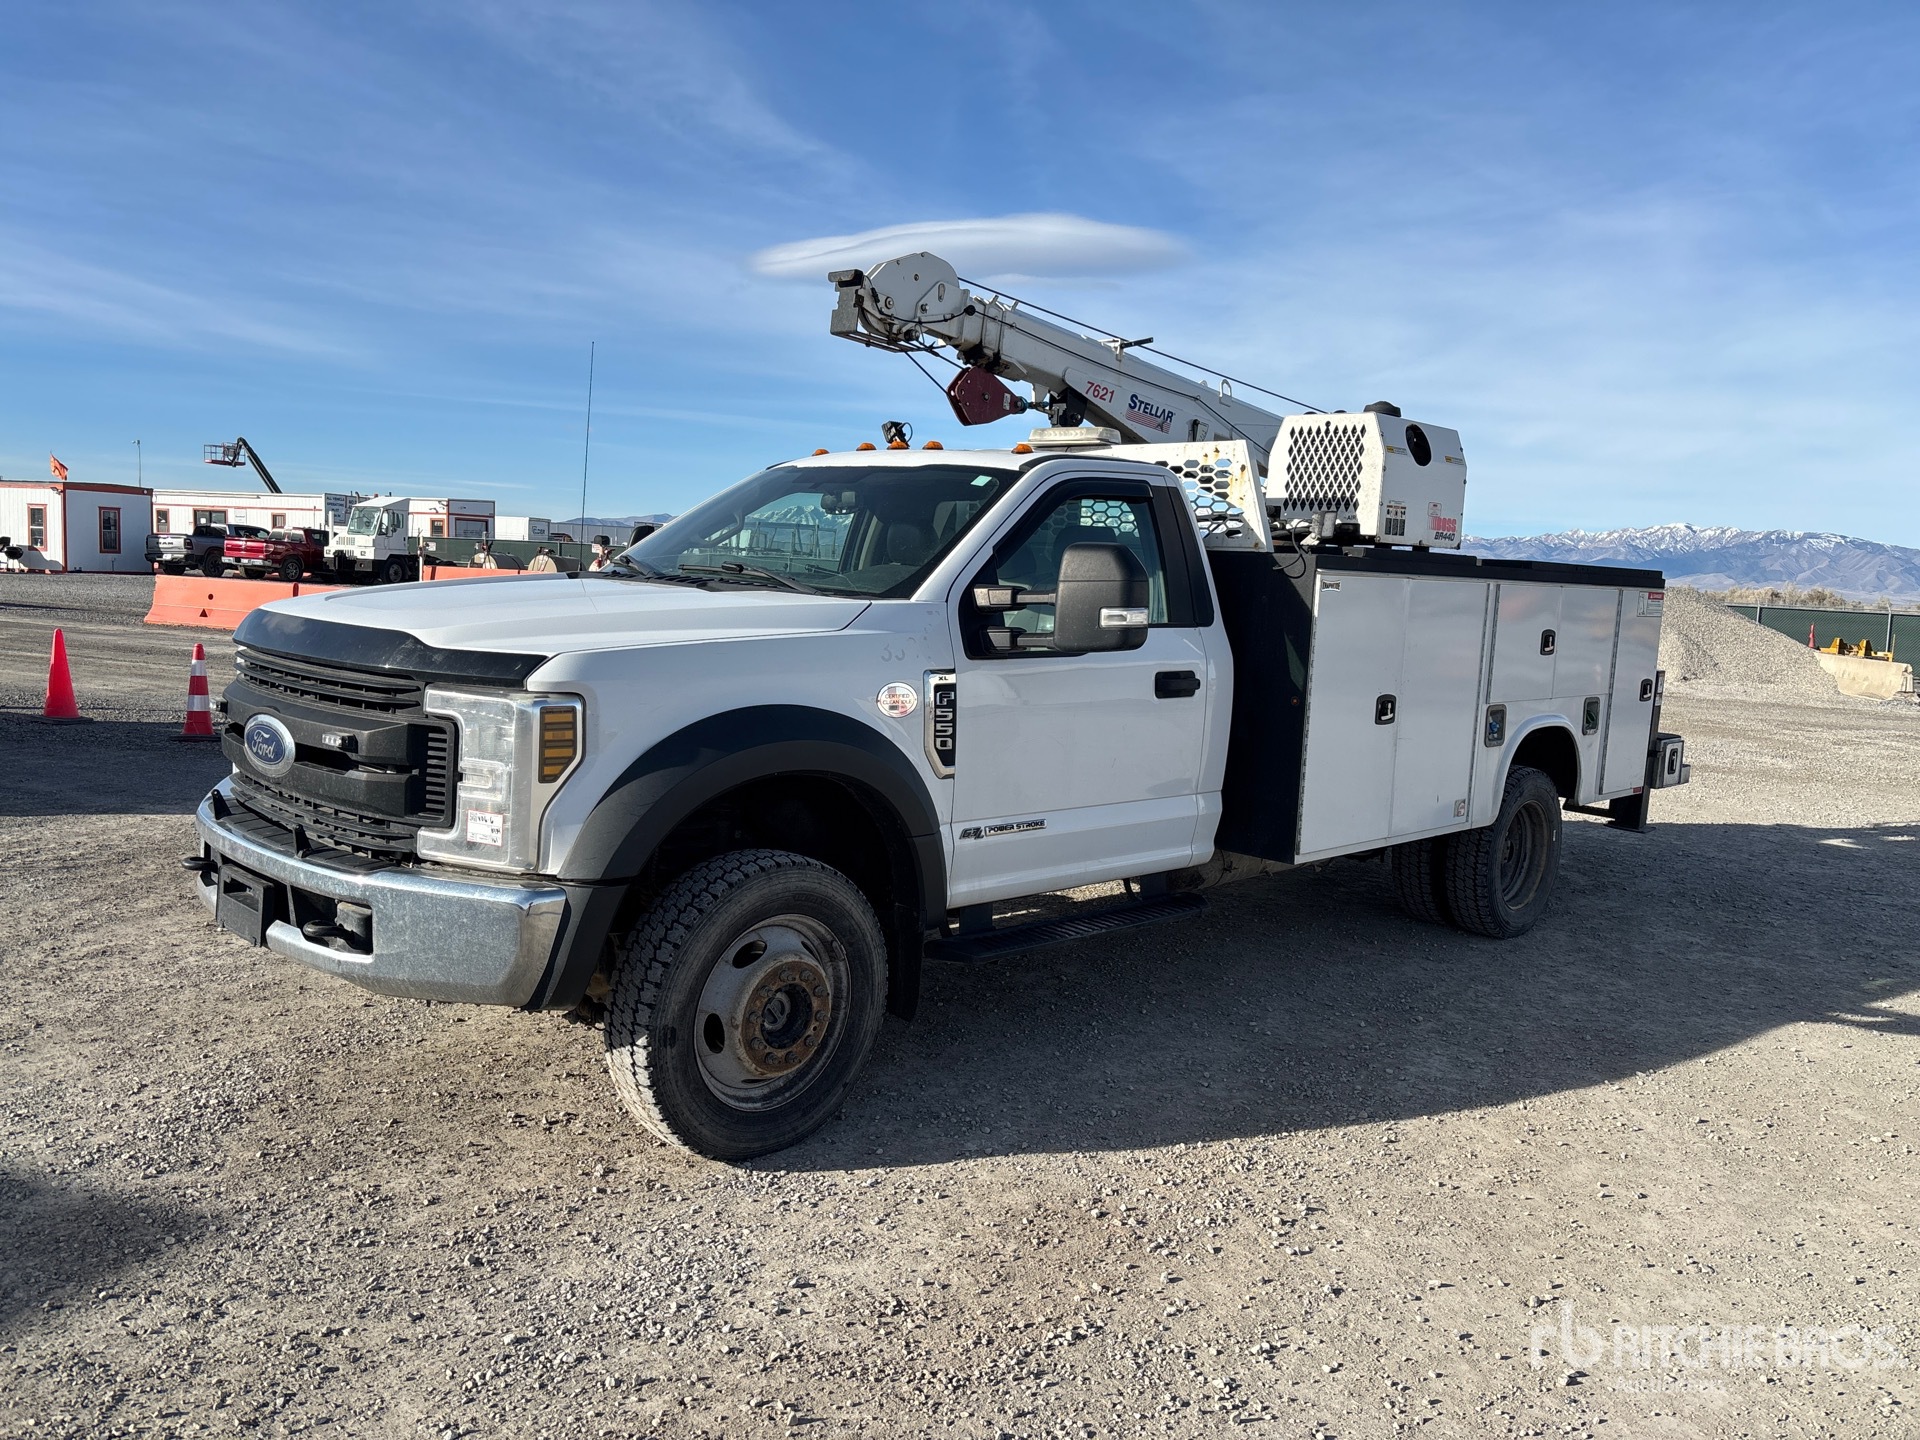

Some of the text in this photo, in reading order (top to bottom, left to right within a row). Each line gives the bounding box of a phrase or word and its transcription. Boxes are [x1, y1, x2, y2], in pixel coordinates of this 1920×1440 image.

[1085, 381, 1115, 403] 7621
[1128, 394, 1174, 423] STELLAR
[1436, 517, 1457, 532] BOSS
[251, 729, 276, 759] Ford
[988, 824, 1015, 834] POWER
[1015, 819, 1046, 830] STROKE
